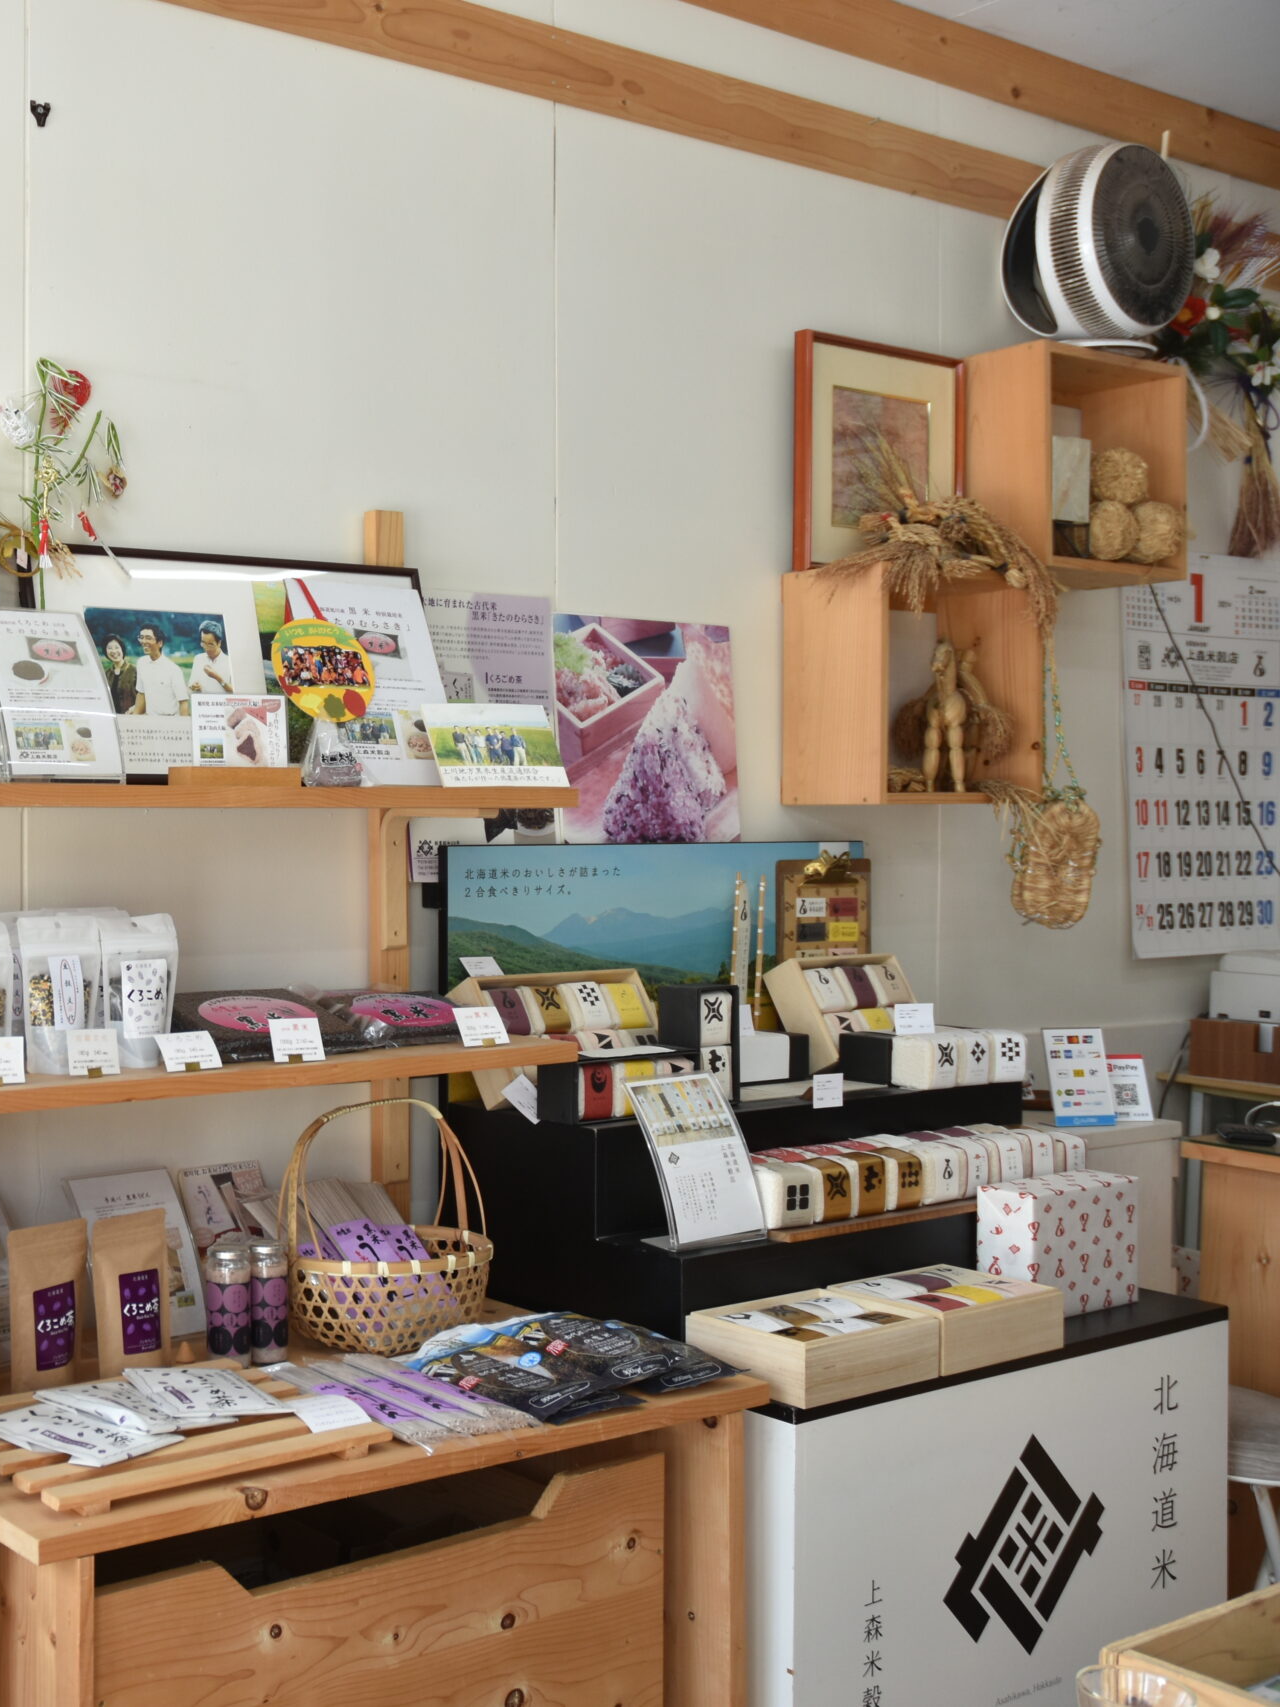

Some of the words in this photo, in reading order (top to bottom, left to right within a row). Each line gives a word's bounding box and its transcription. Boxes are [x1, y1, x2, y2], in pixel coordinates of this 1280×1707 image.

[1190, 572, 1204, 624] 1
[1240, 701, 1249, 726] 1
[1263, 702, 1274, 727] 2
[1135, 746, 1144, 774] 3
[1154, 748, 1163, 774] 4
[1176, 748, 1185, 775] 5
[1196, 749, 1205, 775] 6
[1238, 751, 1248, 776] 8
[1262, 751, 1272, 777] 9
[1135, 799, 1148, 826] 10
[1154, 799, 1168, 826] 11
[1175, 800, 1190, 826] 12
[1195, 800, 1210, 826] 13
[1215, 801, 1230, 826] 14
[1235, 801, 1251, 826] 15
[1258, 801, 1276, 826] 16
[464, 865, 622, 881] 北海道米のおいしさが詰まった
[1136, 851, 1150, 878] 17
[1156, 851, 1171, 877] 18
[1177, 851, 1192, 877] 19
[1196, 851, 1213, 877] 20
[1216, 851, 1232, 876] 21
[1235, 851, 1252, 876] 22
[1256, 851, 1274, 876] 23
[1157, 903, 1175, 930] 25
[1177, 902, 1195, 929] 26
[1198, 902, 1214, 928] 27
[1218, 901, 1234, 928] 28
[1237, 901, 1254, 927] 29
[1257, 900, 1273, 925] 30
[1149, 1373, 1179, 1591] 北海道米
